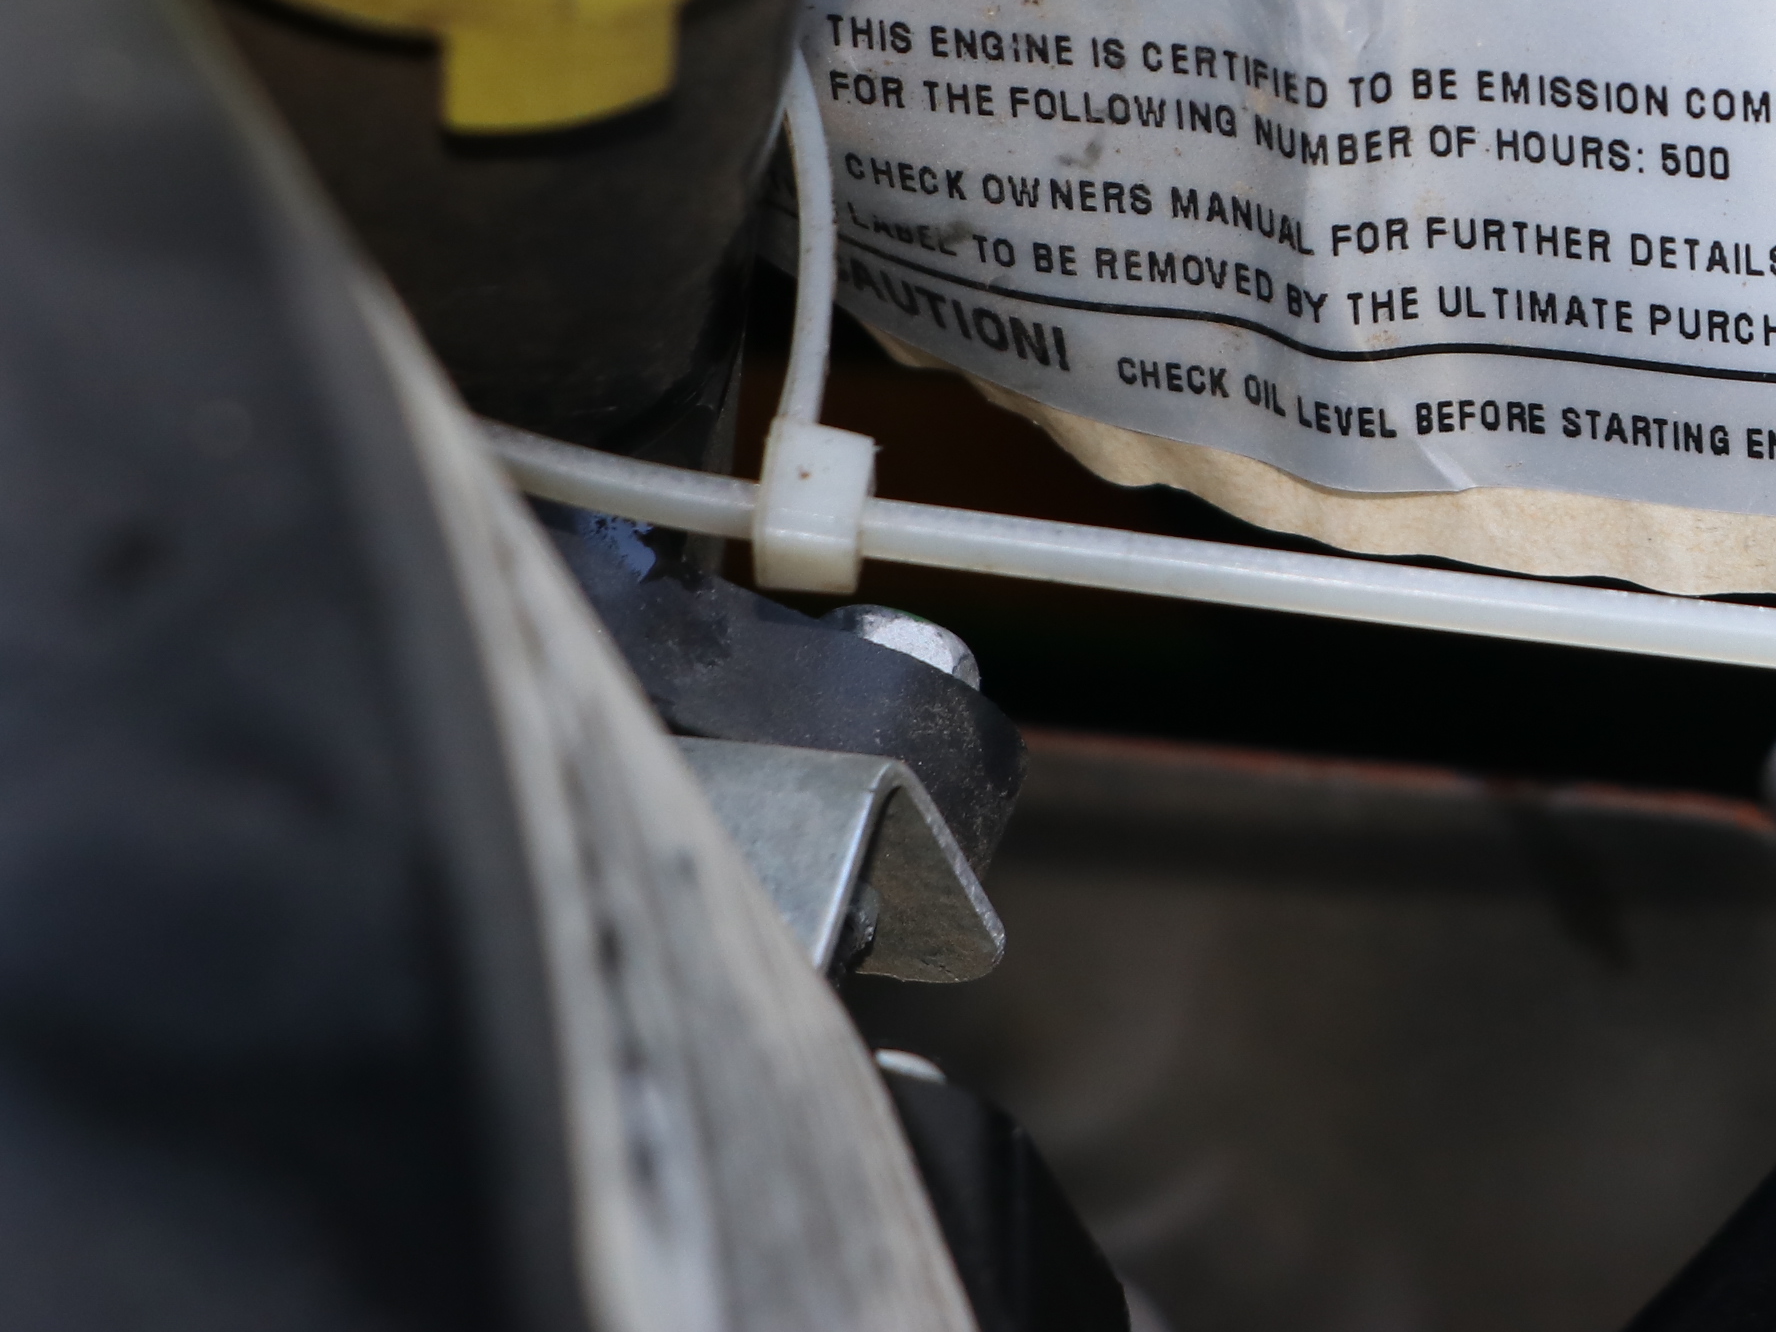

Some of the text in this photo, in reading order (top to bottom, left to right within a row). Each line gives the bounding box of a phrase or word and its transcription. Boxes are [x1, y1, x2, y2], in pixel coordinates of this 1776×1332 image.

[827, 13, 912, 54] THIS
[930, 25, 1073, 67] ENGINE
[1092, 37, 1125, 70] IS
[1142, 40, 1328, 108] CERTIFIED
[1348, 71, 1392, 107] TO
[1412, 68, 1457, 101] BE
[1477, 70, 1669, 118] EMISSION
[829, 70, 1730, 180] FOR THE FOLLOWING NUMBER OF HOURS: 500
[844, 152, 967, 202] CHECK
[982, 173, 1153, 216] OWNERS
[1171, 185, 1315, 256] MANUAL
[1331, 217, 1407, 257] FOR
[1427, 216, 1611, 263] FURTHER
[847, 201, 957, 256] LABEL
[973, 233, 1016, 268] TO
[1033, 242, 1077, 279] BE
[1096, 247, 1273, 304] REMOVED
[1286, 282, 1329, 324] BY
[1346, 286, 1419, 325] THE
[1438, 286, 1634, 335] ULTIMATE
[1117, 356, 1230, 399] CHECK
[1243, 373, 1286, 417] OIL
[1298, 395, 1397, 439] LEVEL
[1416, 400, 1546, 437] BEFORE
[1561, 407, 1730, 457] STARTING
